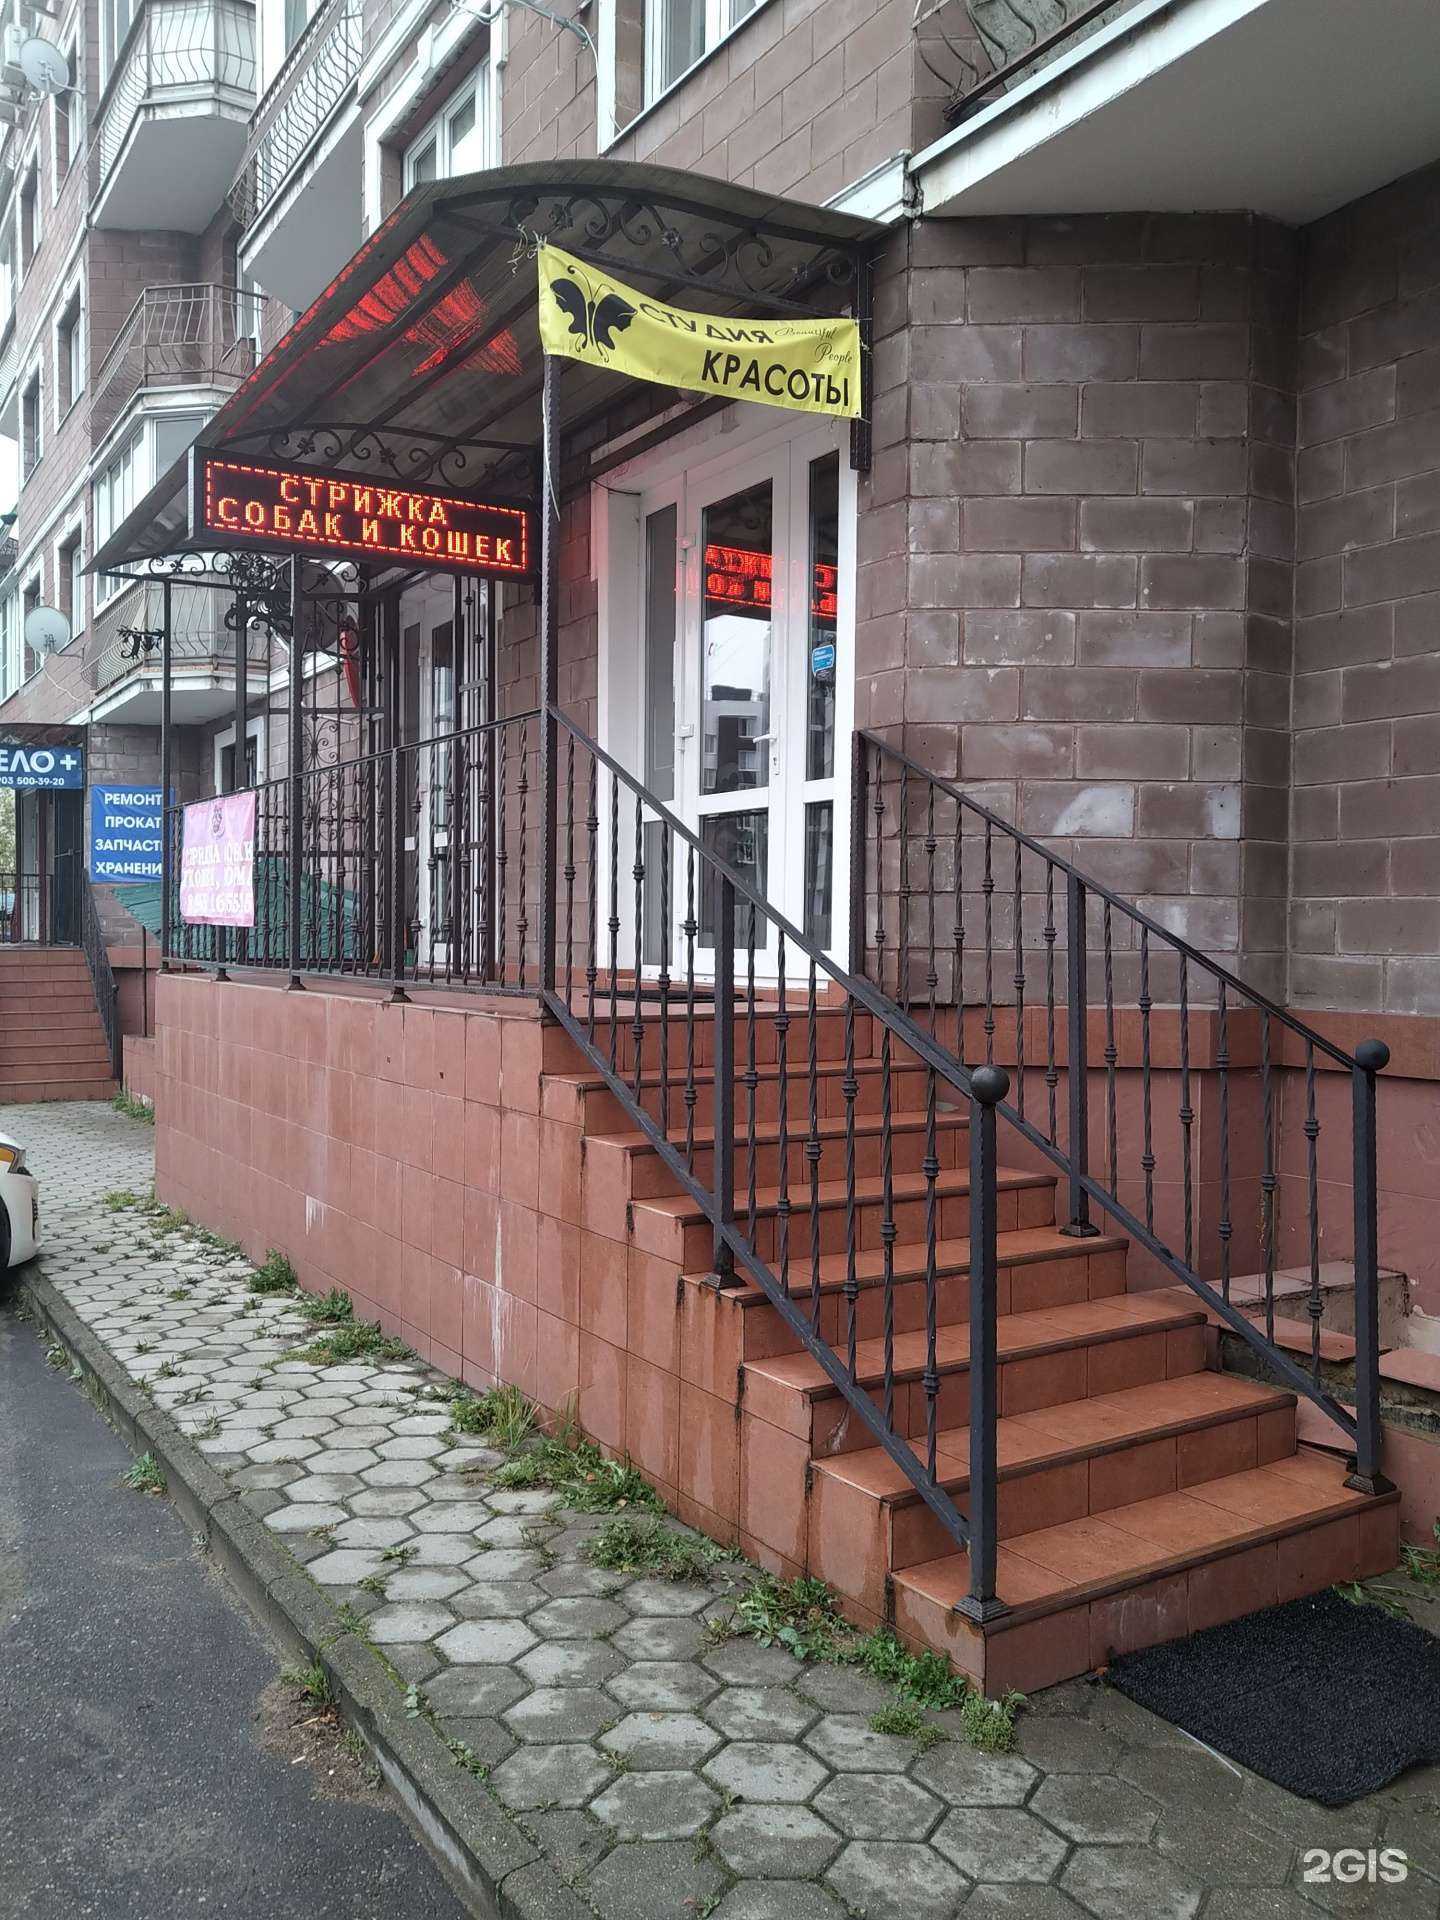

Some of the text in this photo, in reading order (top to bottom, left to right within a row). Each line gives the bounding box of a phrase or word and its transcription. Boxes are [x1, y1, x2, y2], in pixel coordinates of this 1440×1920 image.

[638, 302, 775, 344] СТУДИЯ
[814, 342, 853, 367] People
[701, 349, 849, 407] КРАСОТЫ
[280, 478, 448, 525] СТРИЖКА
[217, 497, 513, 561] СОБАК И КОШЕК
[0, 748, 55, 774] ЕЛО
[0, 776, 65, 787] 03 500-39-20
[104, 792, 163, 806] РЕМОНТ
[104, 815, 163, 829] ПРОКАТ
[95, 861, 163, 875] ХРАНЕНИ
